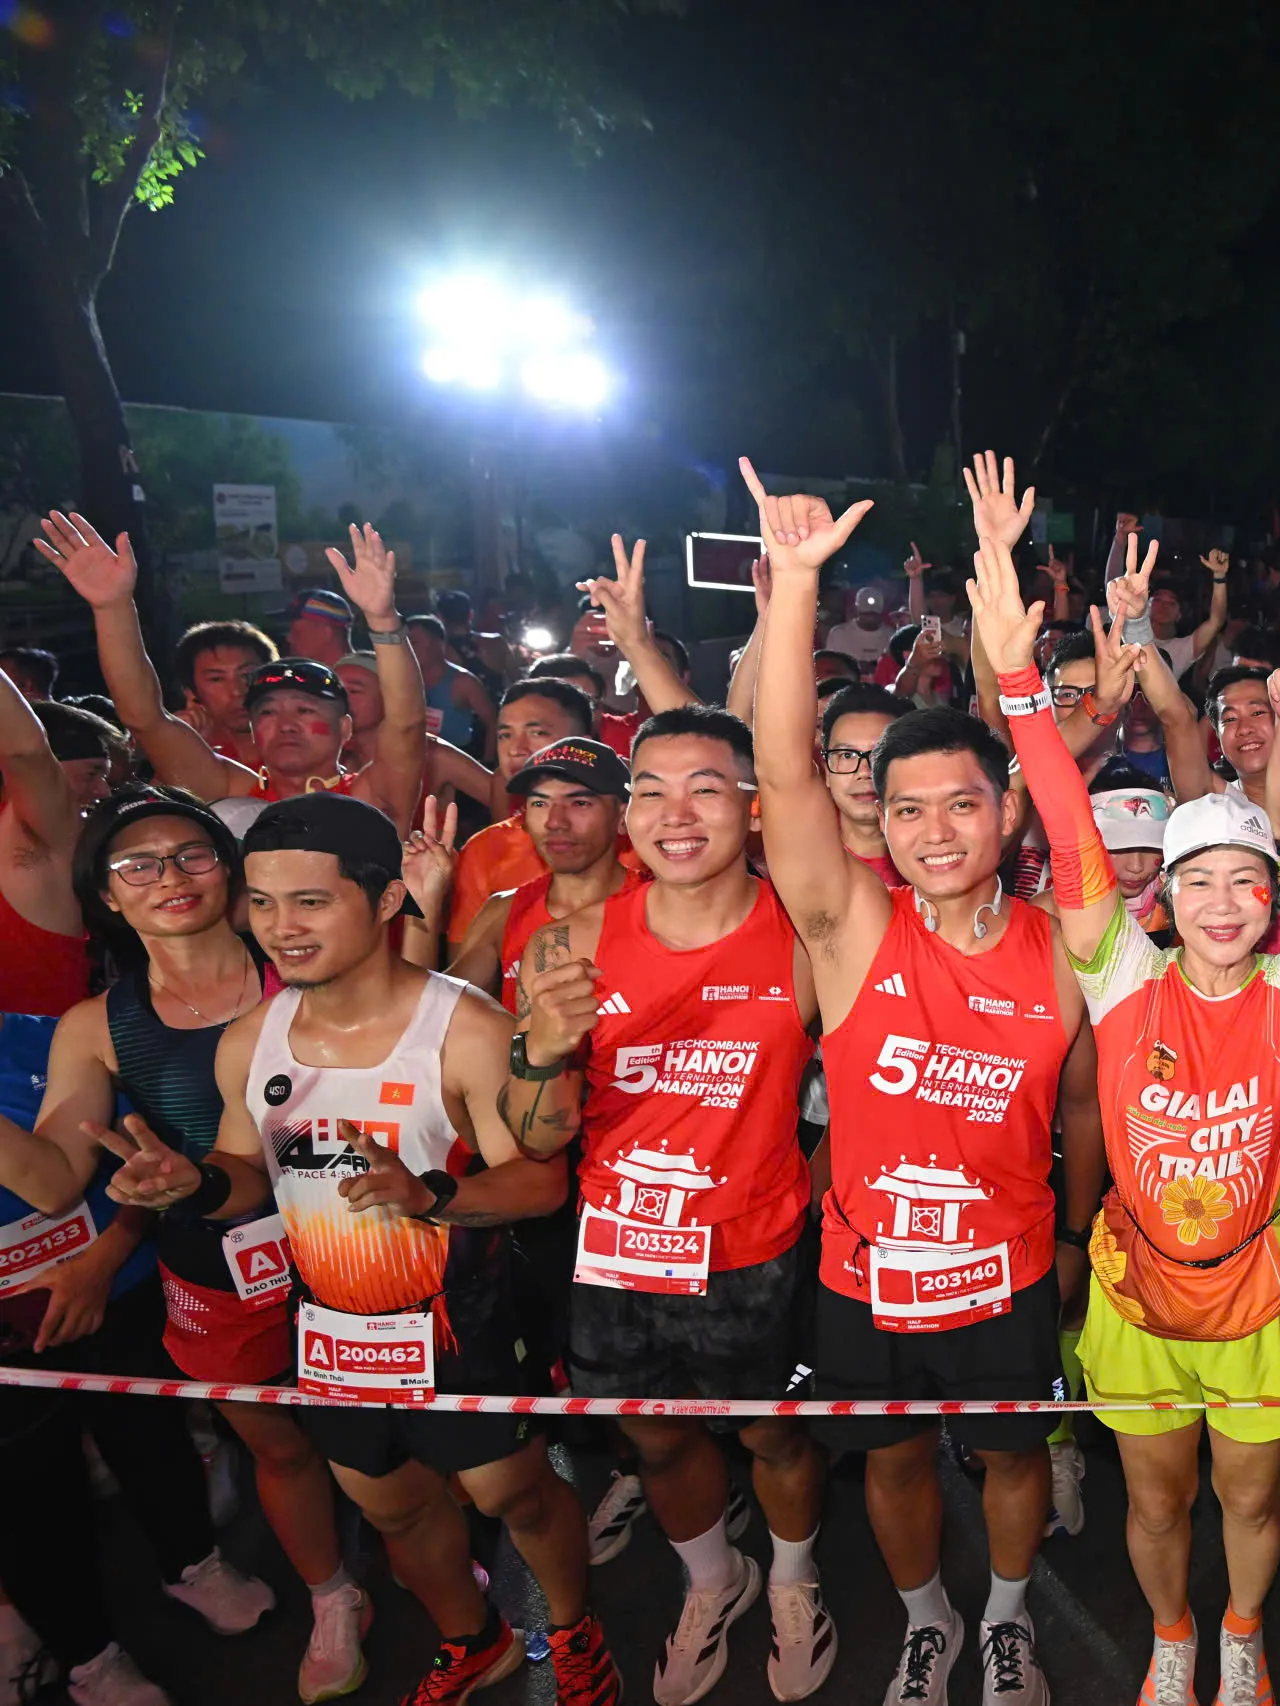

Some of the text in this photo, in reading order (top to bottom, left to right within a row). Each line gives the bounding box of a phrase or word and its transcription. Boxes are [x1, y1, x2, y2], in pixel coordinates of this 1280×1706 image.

[1240, 825, 1268, 840] adidas
[719, 985, 749, 993] HANOI
[985, 998, 1015, 1009] HANOI
[669, 1039, 760, 1051] TECHCOMBANK
[629, 1055, 661, 1065] Edition
[664, 1050, 756, 1075] HANOI
[895, 1048, 925, 1061] Edition
[935, 1043, 1028, 1069] TECHCOMBANK
[661, 1072, 747, 1083] INTERNATIONAL
[924, 1055, 1024, 1092] HANOI
[653, 1080, 745, 1097] MARATHON
[920, 1079, 1012, 1099] INTERNATIONAL
[700, 1096, 739, 1109] 2026
[915, 1086, 1010, 1111] MARATHON
[1140, 1075, 1259, 1121] GIA LAI
[966, 1109, 1004, 1123] 2026
[1190, 1112, 1259, 1153] CITY
[298, 1170, 327, 1179] PACE
[330, 1170, 352, 1179] 4:50
[1158, 1150, 1244, 1183] TRAIL
[0, 1223, 80, 1267] 202133
[624, 1229, 700, 1254] 203324
[249, 1250, 279, 1278] A
[921, 1262, 998, 1292] 203140
[309, 1338, 421, 1365] A 200462
[303, 1368, 312, 1376] Mr
[328, 1391, 359, 1399] MARATHON
[671, 1405, 688, 1415] AREA
[689, 1405, 717, 1414] ALLOWED
